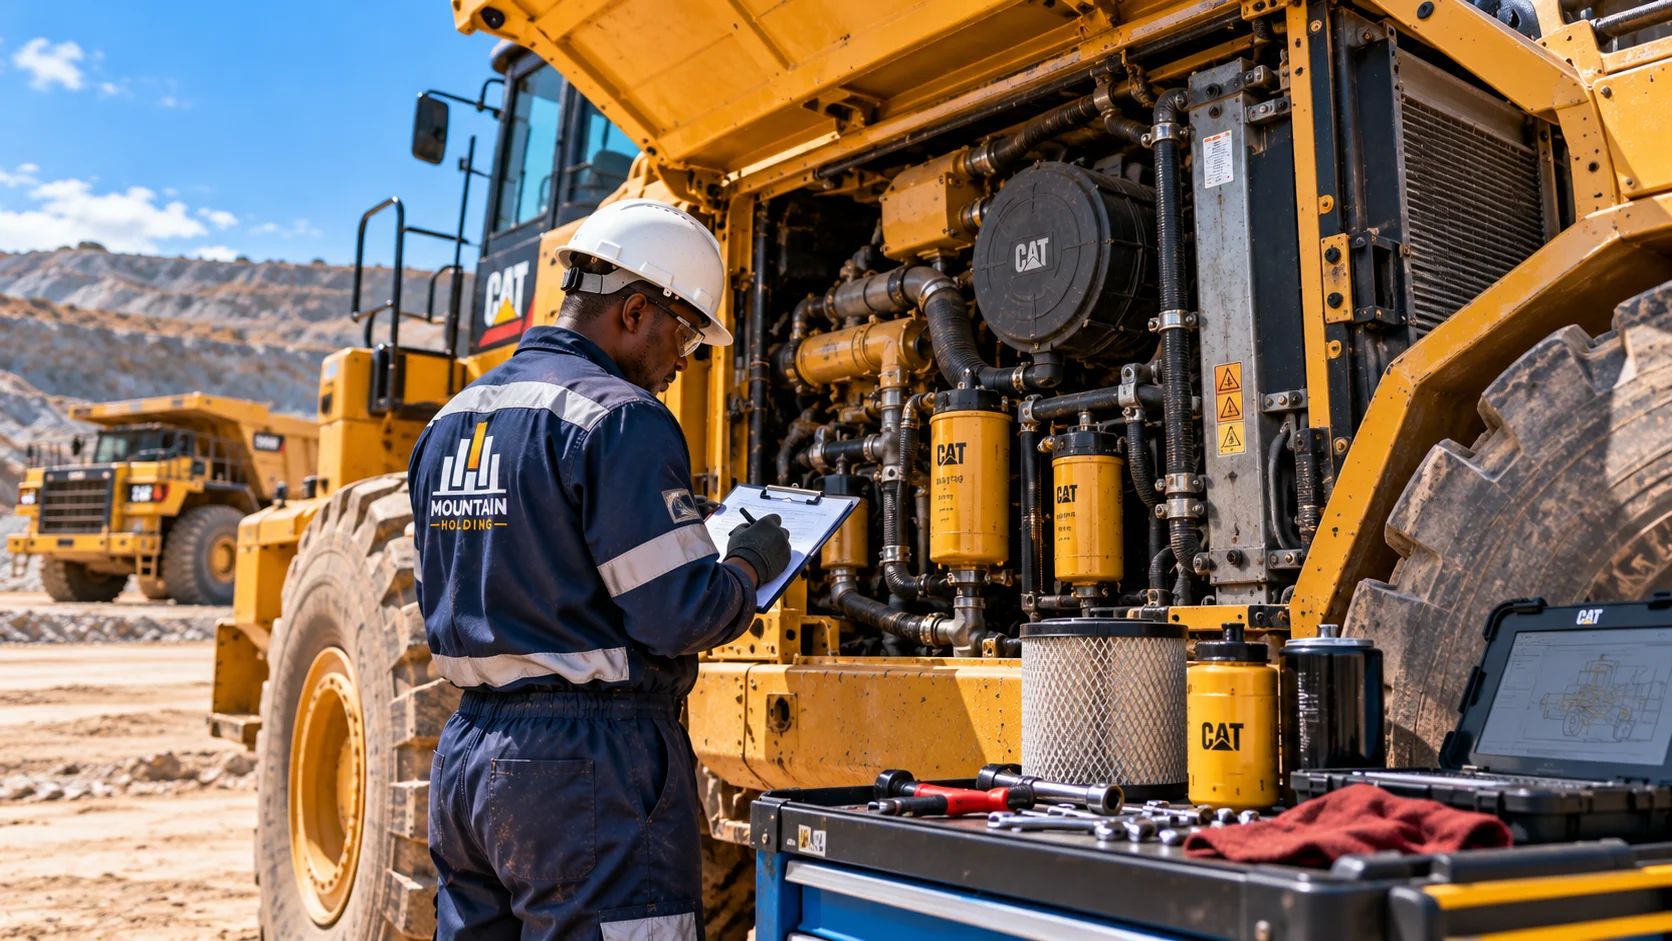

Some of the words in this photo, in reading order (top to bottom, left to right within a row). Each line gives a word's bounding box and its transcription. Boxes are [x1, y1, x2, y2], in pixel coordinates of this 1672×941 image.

[1015, 237, 1049, 273] CAT
[484, 260, 530, 328] CAT
[937, 442, 967, 467] CAT
[1057, 484, 1078, 504] CAT
[431, 498, 507, 517] MOUNTAIN
[441, 518, 493, 531] HOLDING
[1576, 608, 1604, 625] CAT
[1202, 721, 1244, 752] CAT
